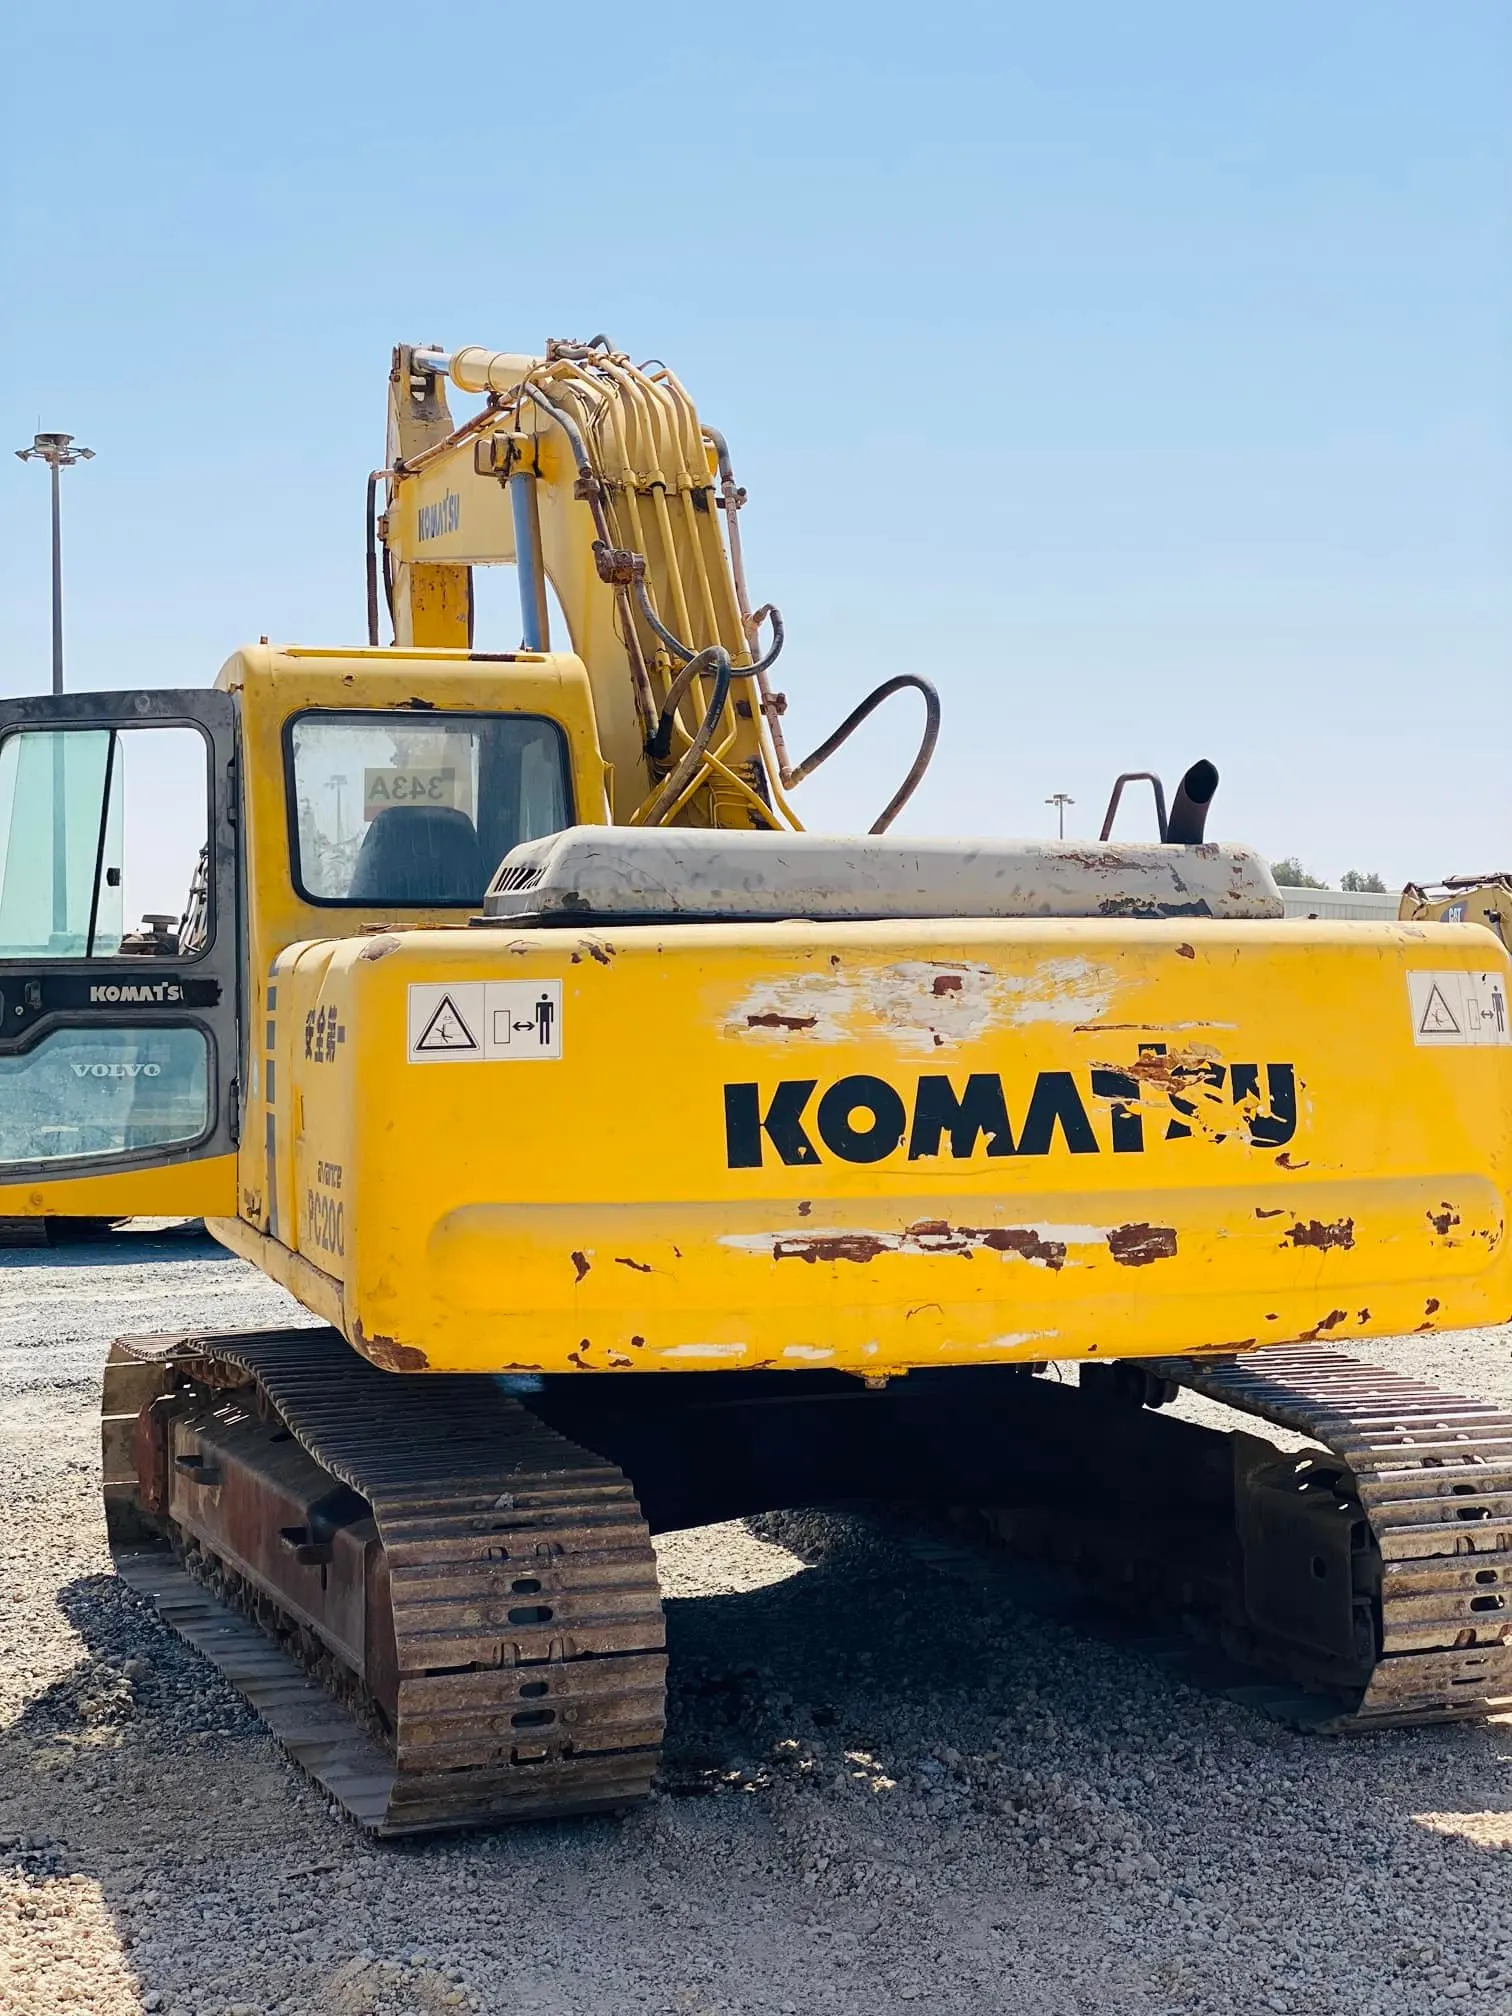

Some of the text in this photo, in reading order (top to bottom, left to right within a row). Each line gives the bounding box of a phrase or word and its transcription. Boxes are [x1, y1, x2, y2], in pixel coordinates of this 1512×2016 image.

[418, 487, 460, 543] KOMATSU
[90, 981, 184, 1002] KOMATS
[70, 1063, 161, 1077] VOLVO
